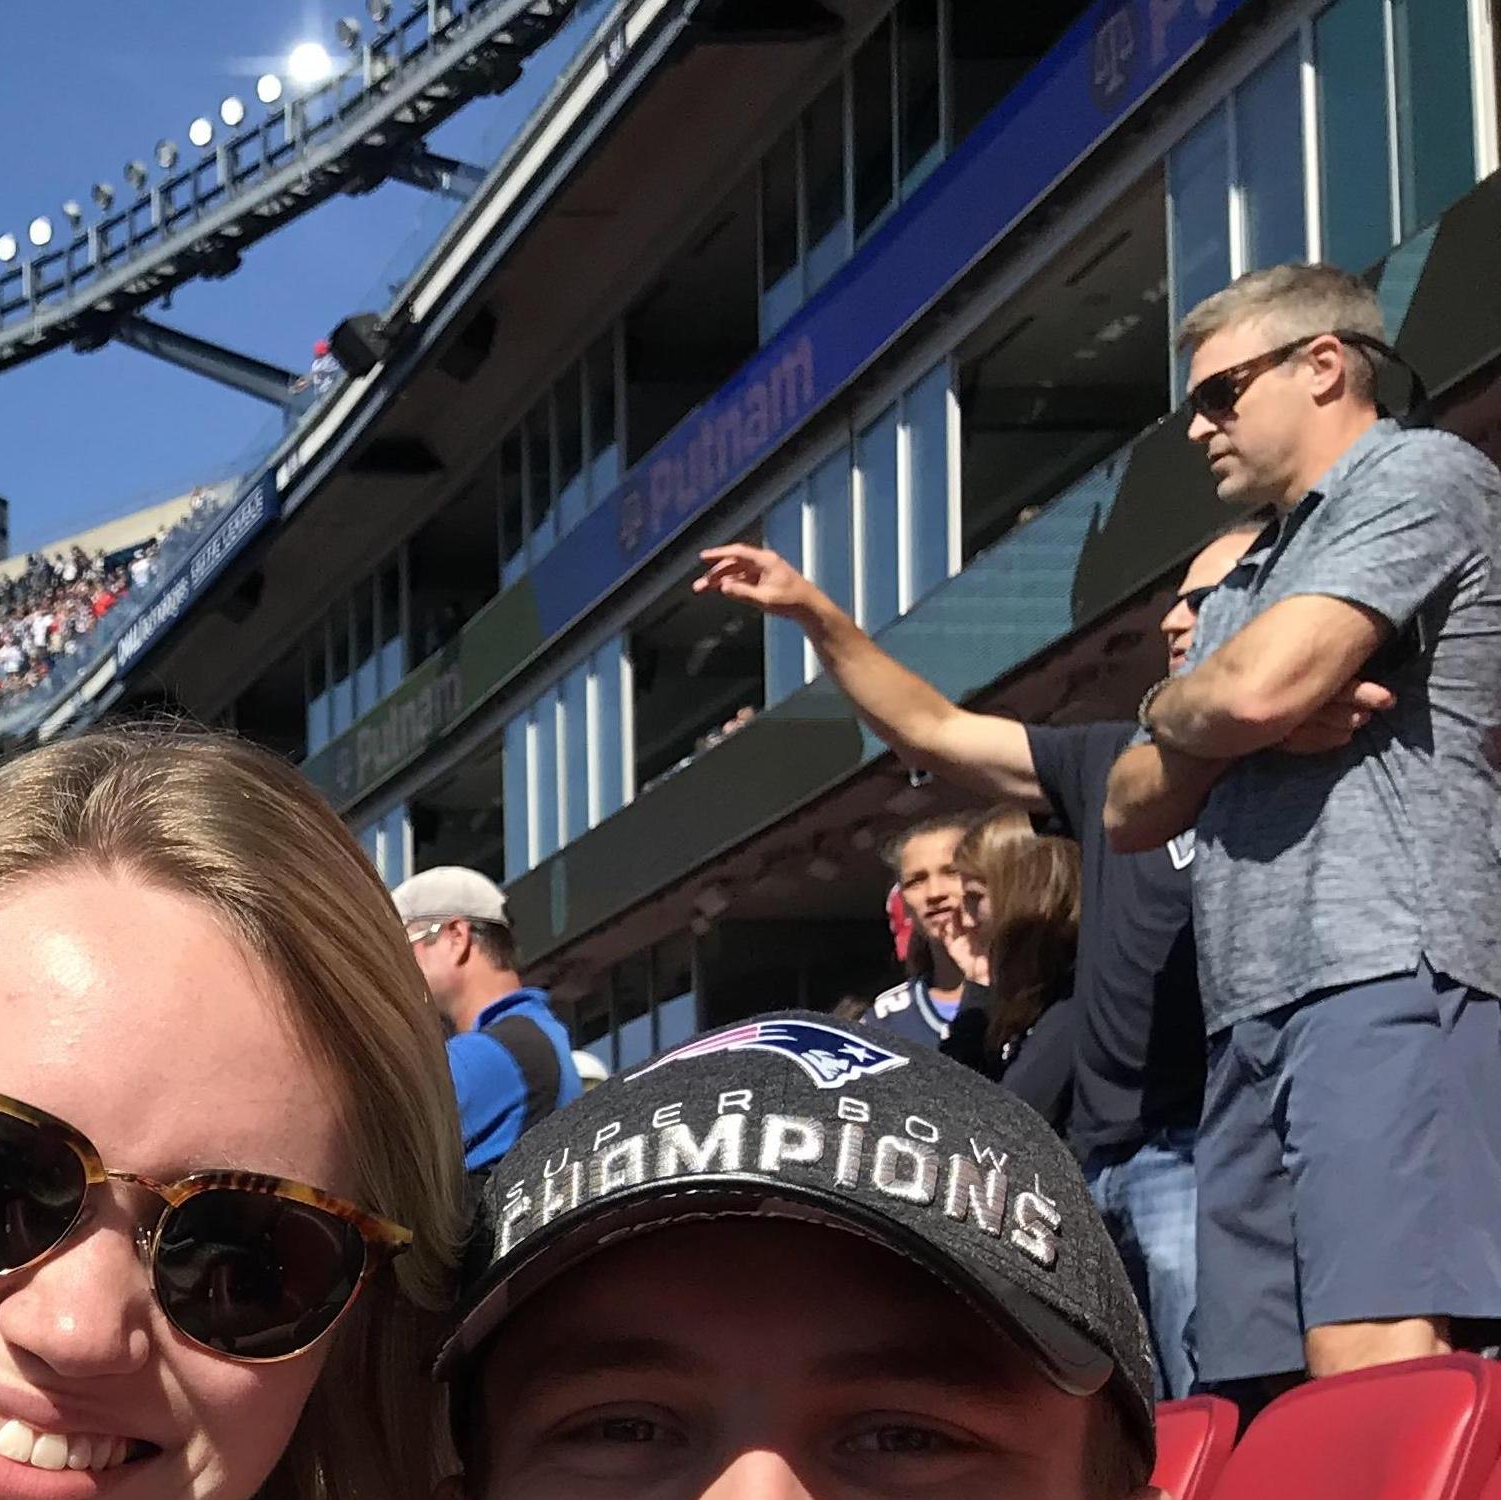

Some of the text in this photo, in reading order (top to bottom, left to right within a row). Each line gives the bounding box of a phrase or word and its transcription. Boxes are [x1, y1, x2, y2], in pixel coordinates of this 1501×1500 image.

[652, 336, 814, 533] Putnam
[499, 1113, 1062, 1266] CHAMPIONS
[502, 1089, 1056, 1212] SUPER BOWL
